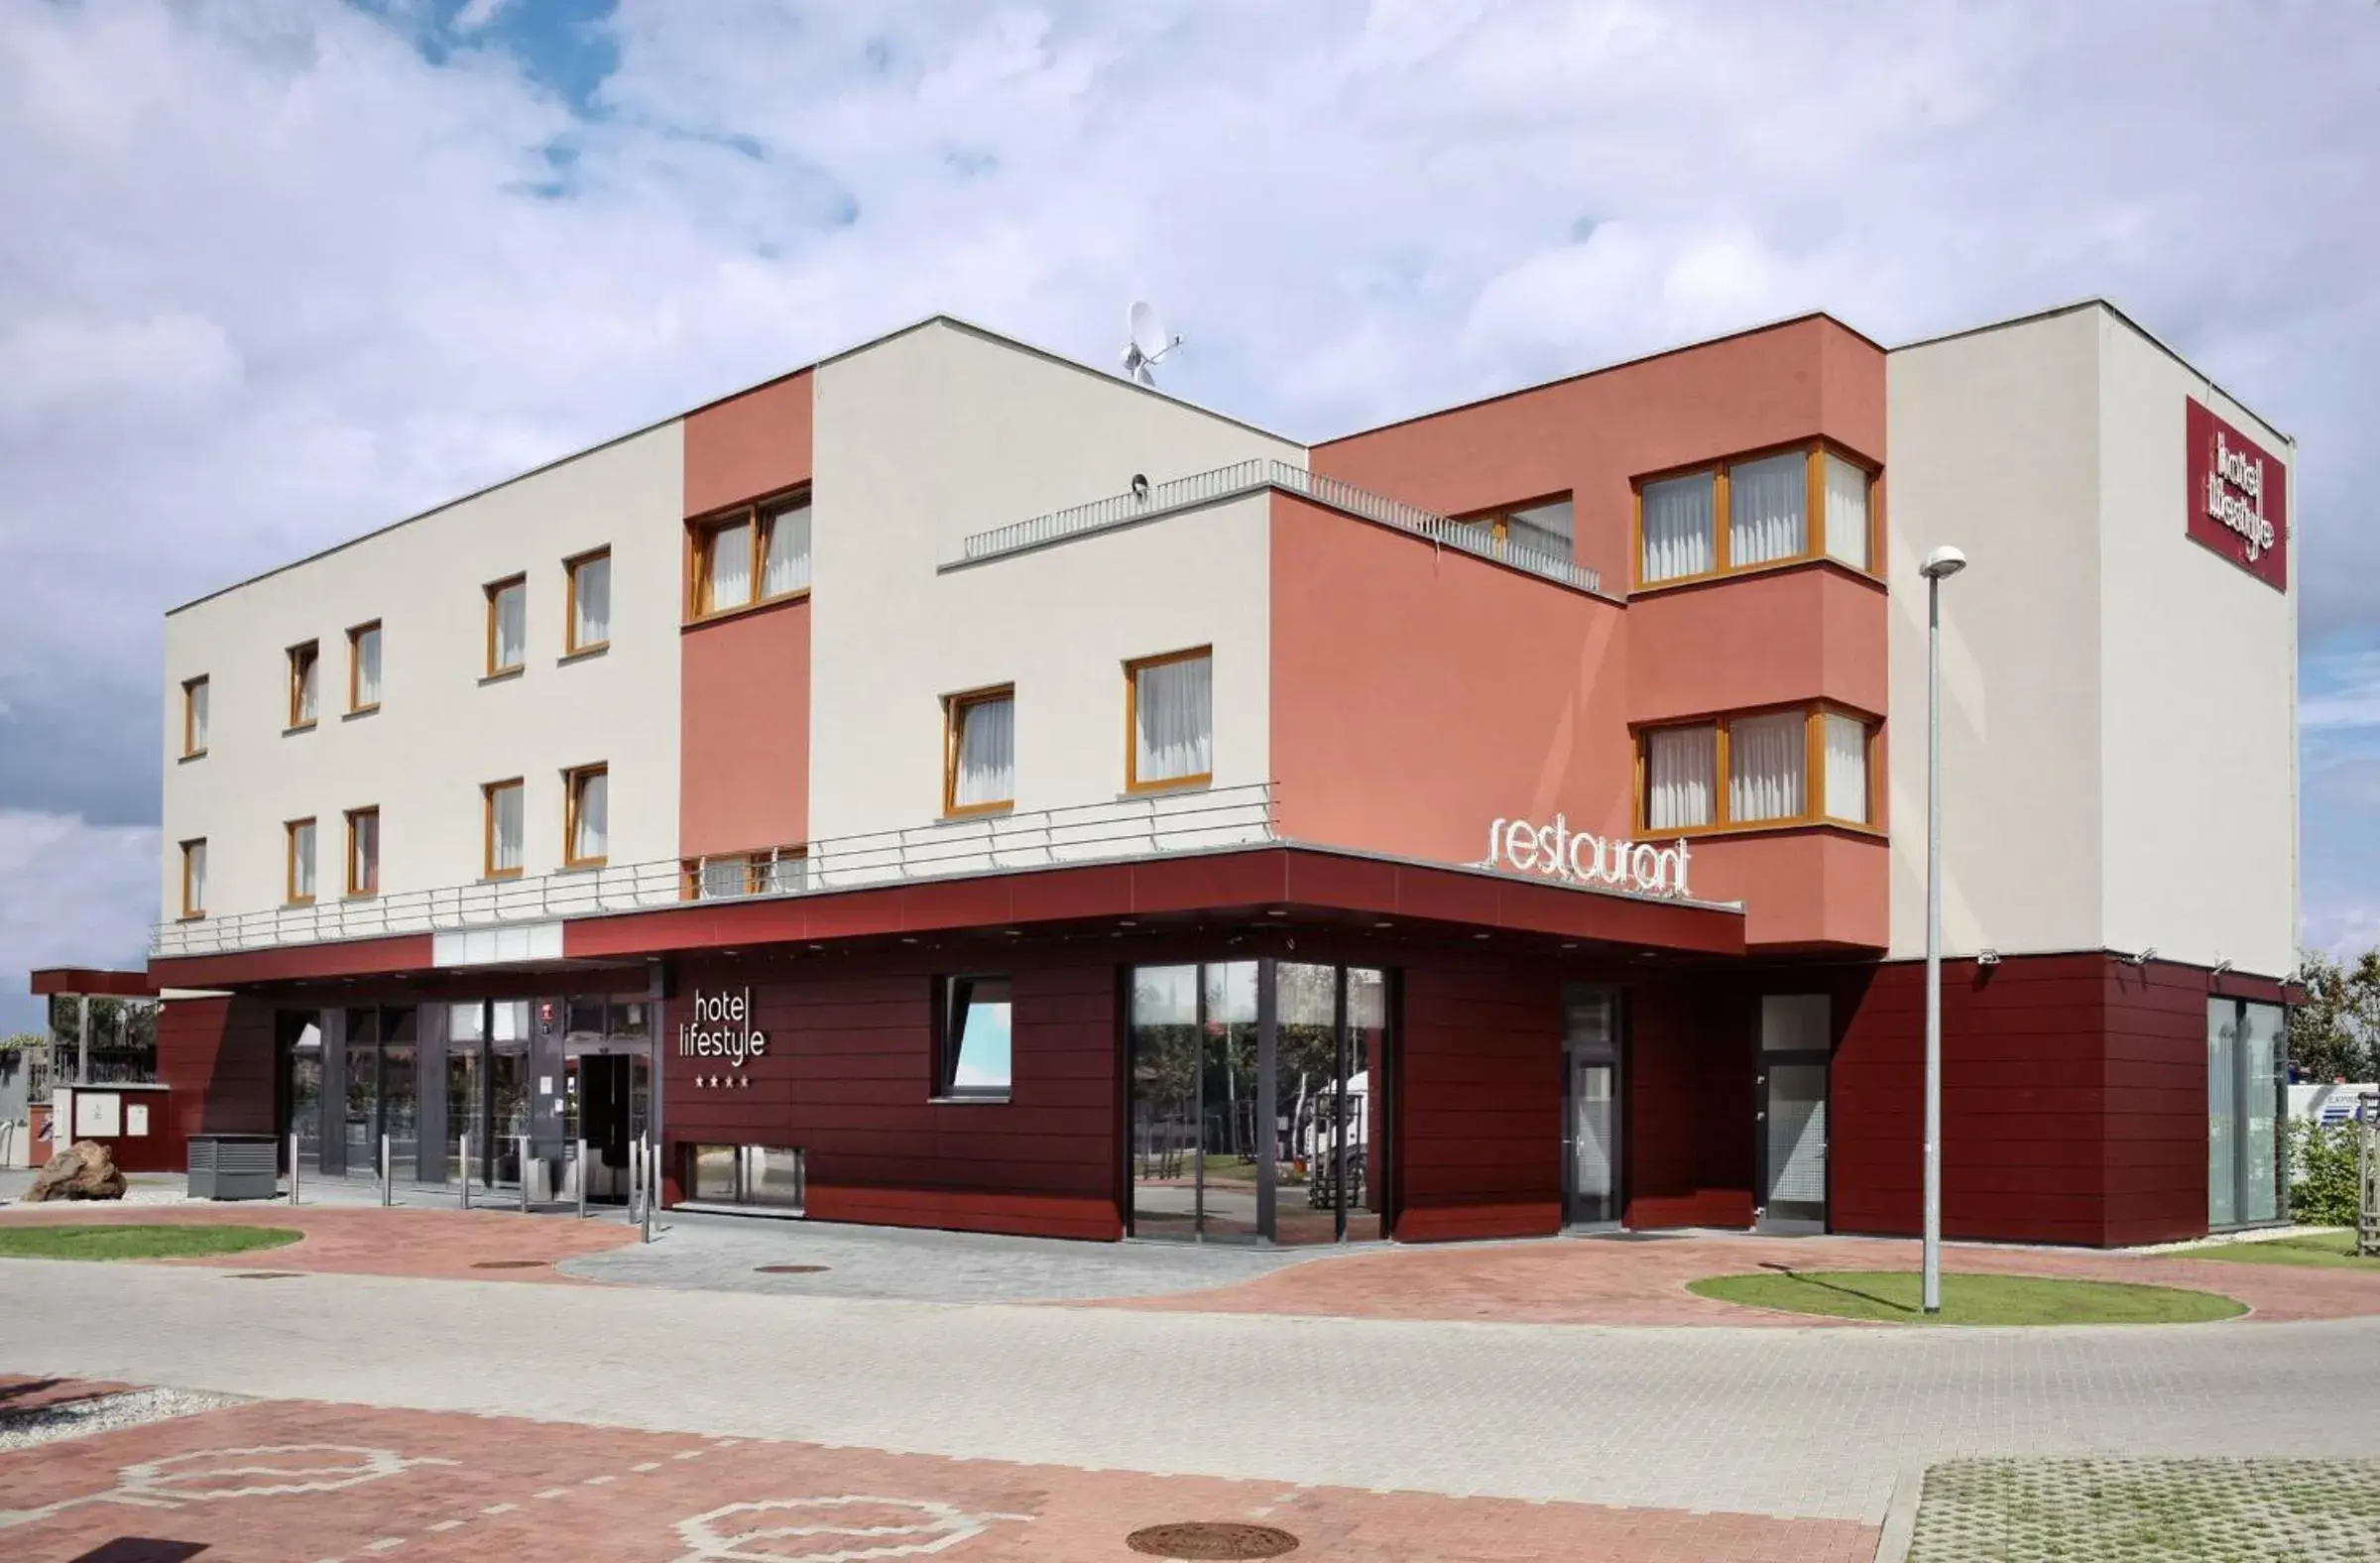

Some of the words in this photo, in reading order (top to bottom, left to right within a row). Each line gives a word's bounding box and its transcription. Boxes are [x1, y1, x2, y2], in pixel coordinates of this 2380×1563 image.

[2217, 431, 2263, 497] hotel
[2208, 471, 2274, 561] lifestyle
[1489, 813, 1692, 895] restaurant
[695, 986, 750, 1023] hotel
[679, 1022, 765, 1067] lifestyle
